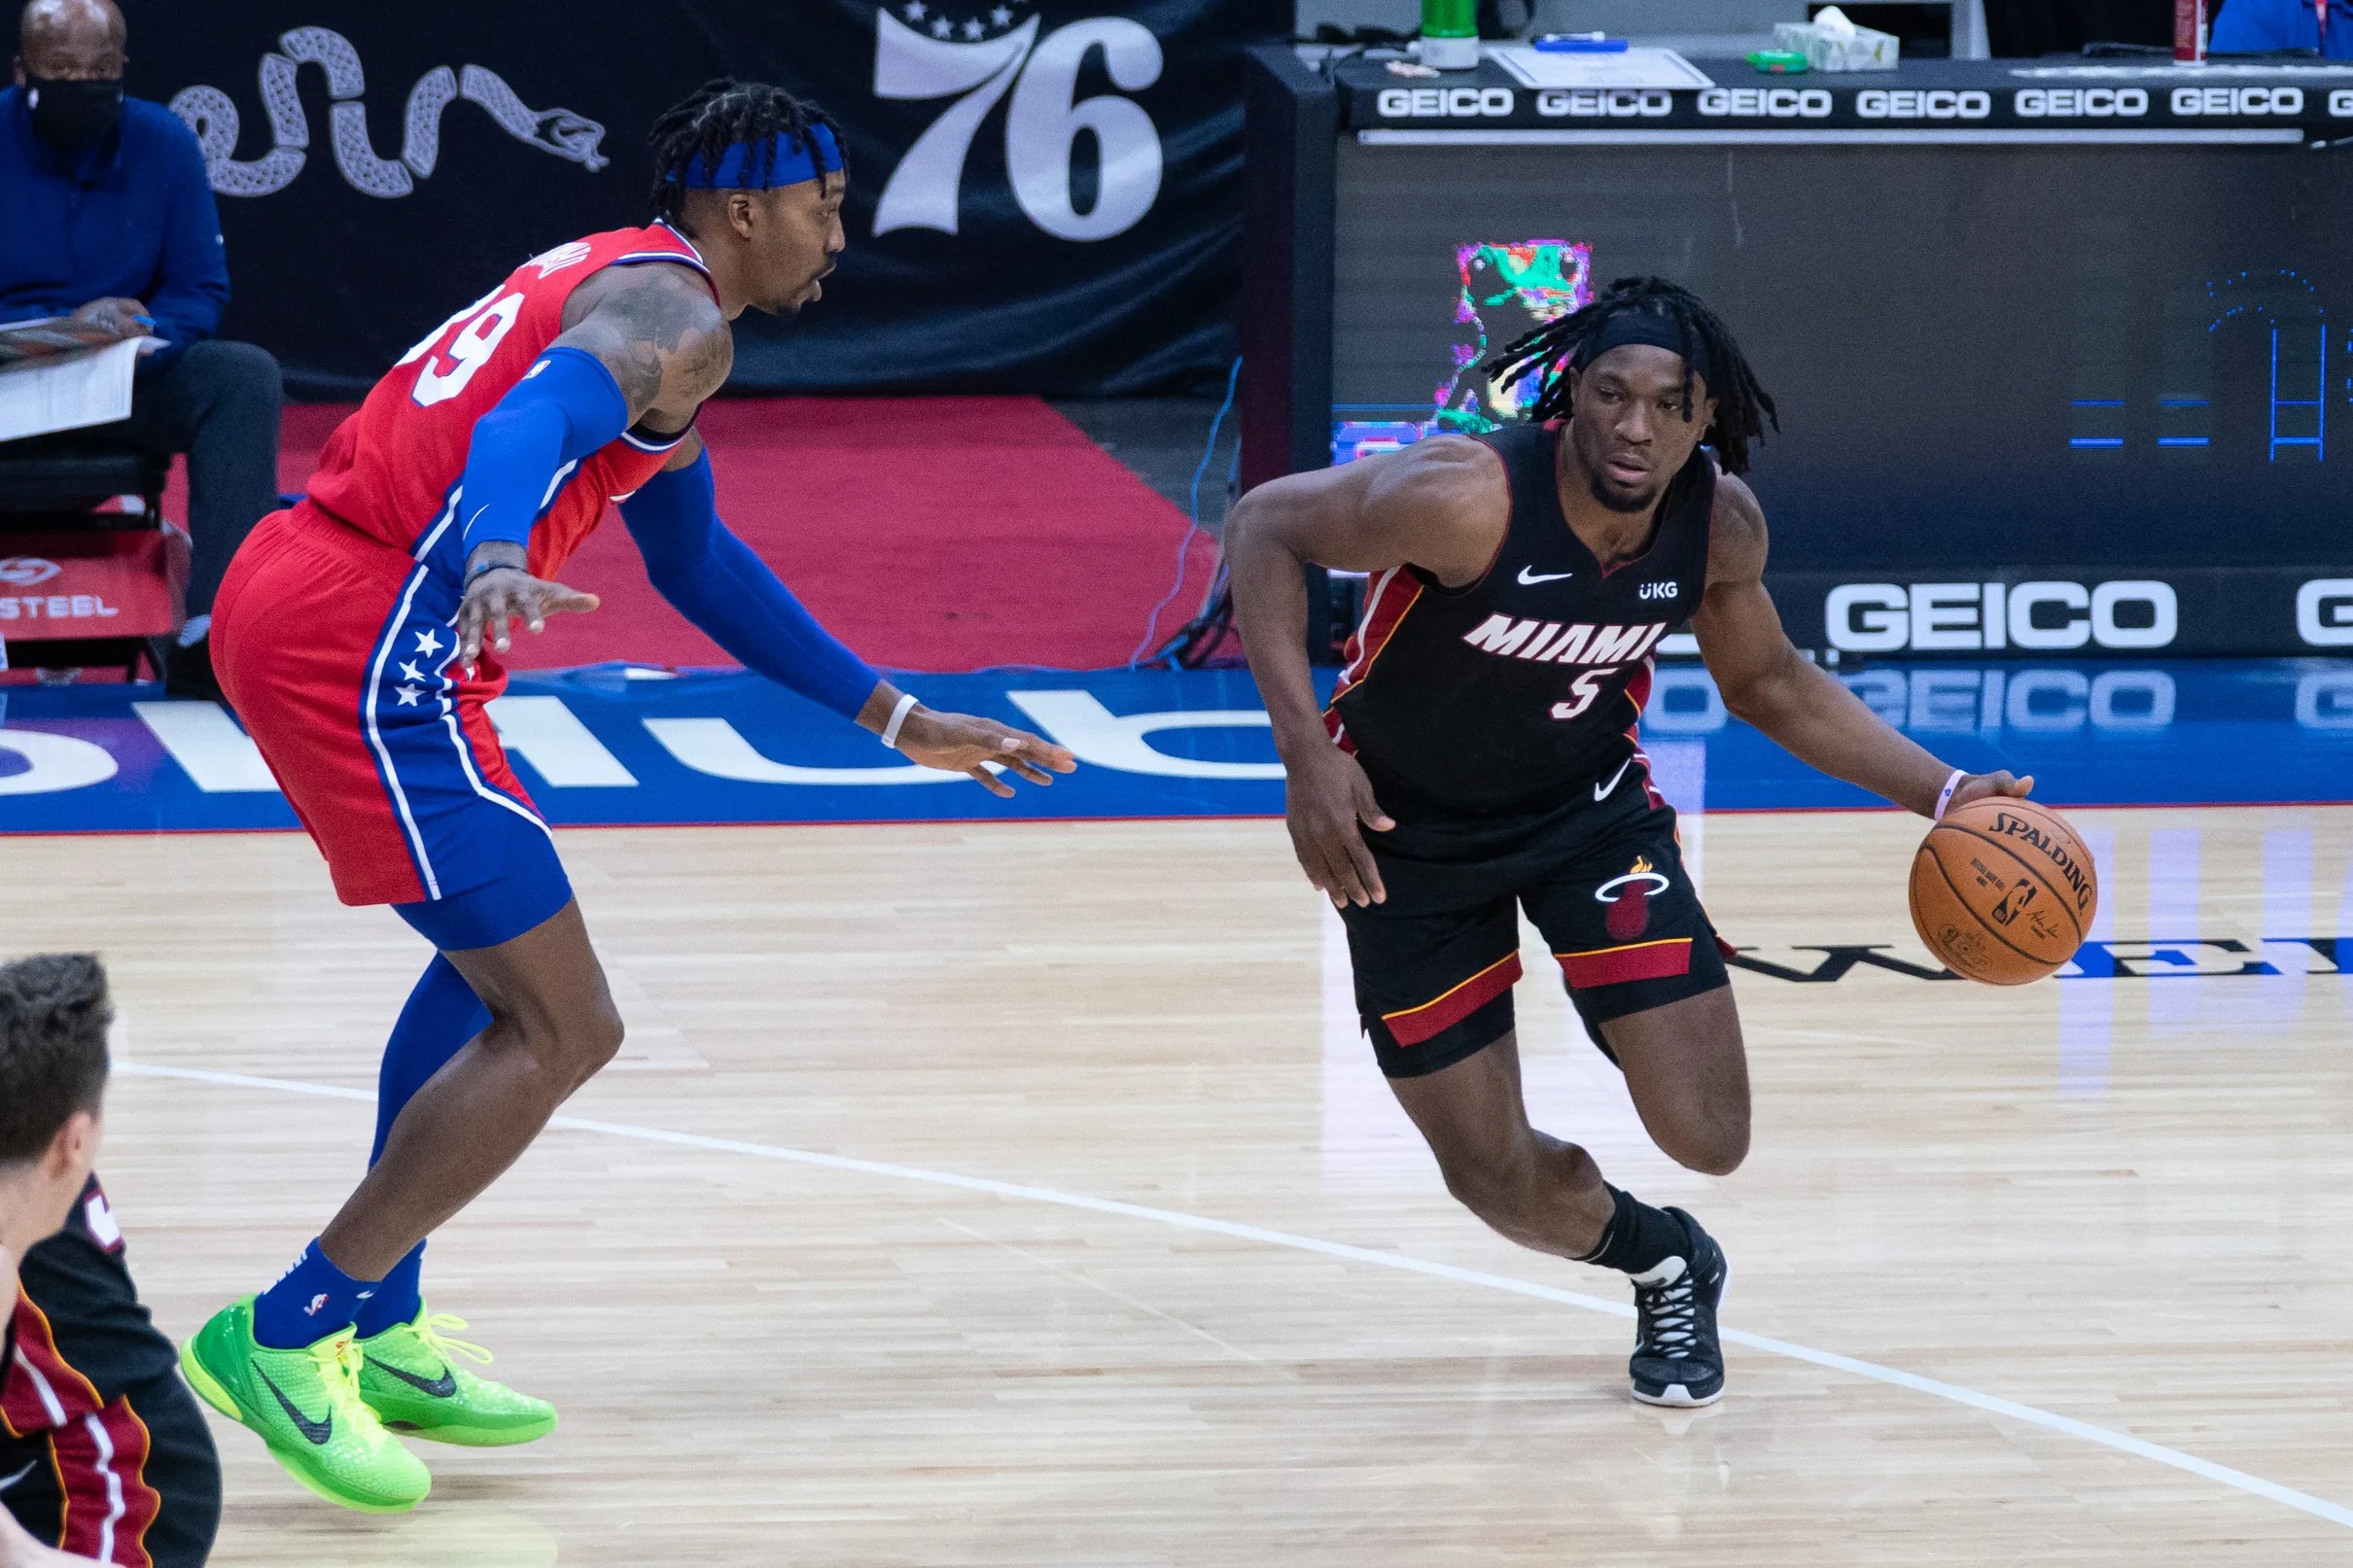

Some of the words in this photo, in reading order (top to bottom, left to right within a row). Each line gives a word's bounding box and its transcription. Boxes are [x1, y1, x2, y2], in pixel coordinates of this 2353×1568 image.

[873, 6, 1163, 242] 76
[1377, 87, 1514, 118] GEICO
[1537, 88, 1672, 118] GEICO
[1697, 87, 1833, 118] GEICO
[1856, 89, 1991, 119] GEICO
[2014, 88, 2148, 118] GEICO
[2171, 87, 2304, 116] GEICO
[1461, 611, 1668, 665] MIAMI
[1825, 580, 2178, 651] GEICO
[1549, 666, 1622, 721] 5
[1988, 812, 2093, 911] SPALDING
